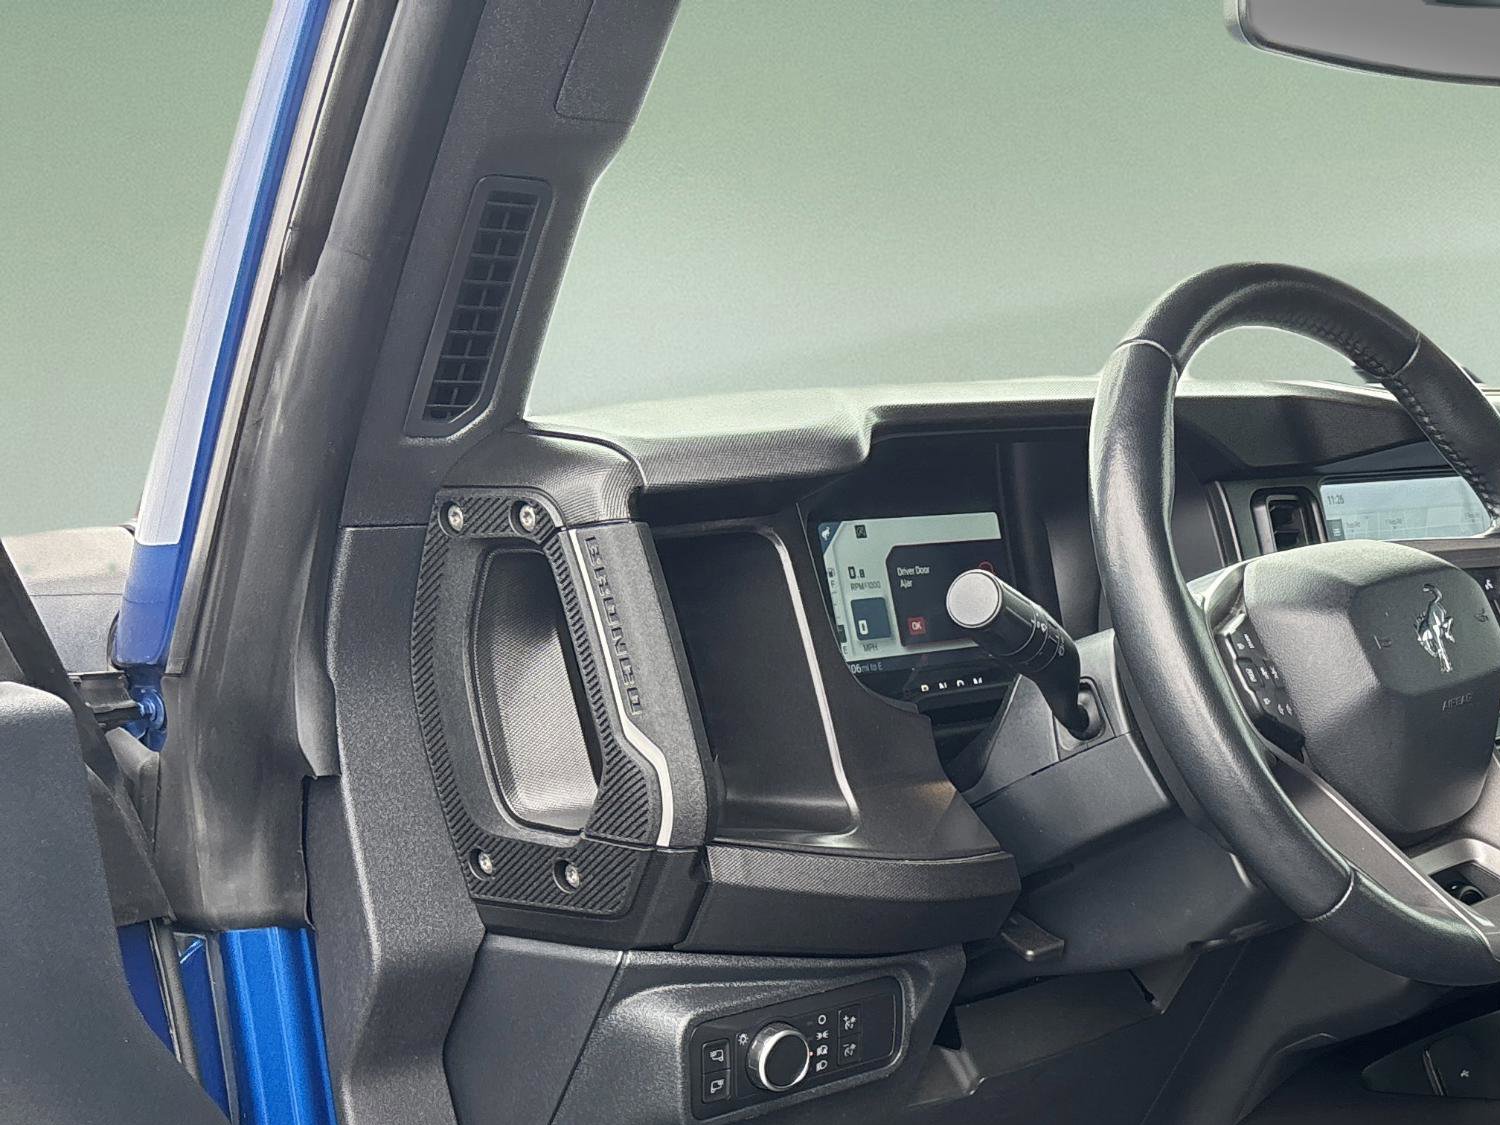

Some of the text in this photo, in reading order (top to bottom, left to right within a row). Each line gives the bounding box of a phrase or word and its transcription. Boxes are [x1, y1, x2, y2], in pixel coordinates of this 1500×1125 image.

[896, 565, 930, 577] Driver Door
[585, 536, 642, 716] BRONCO
[911, 621, 922, 630] OK
